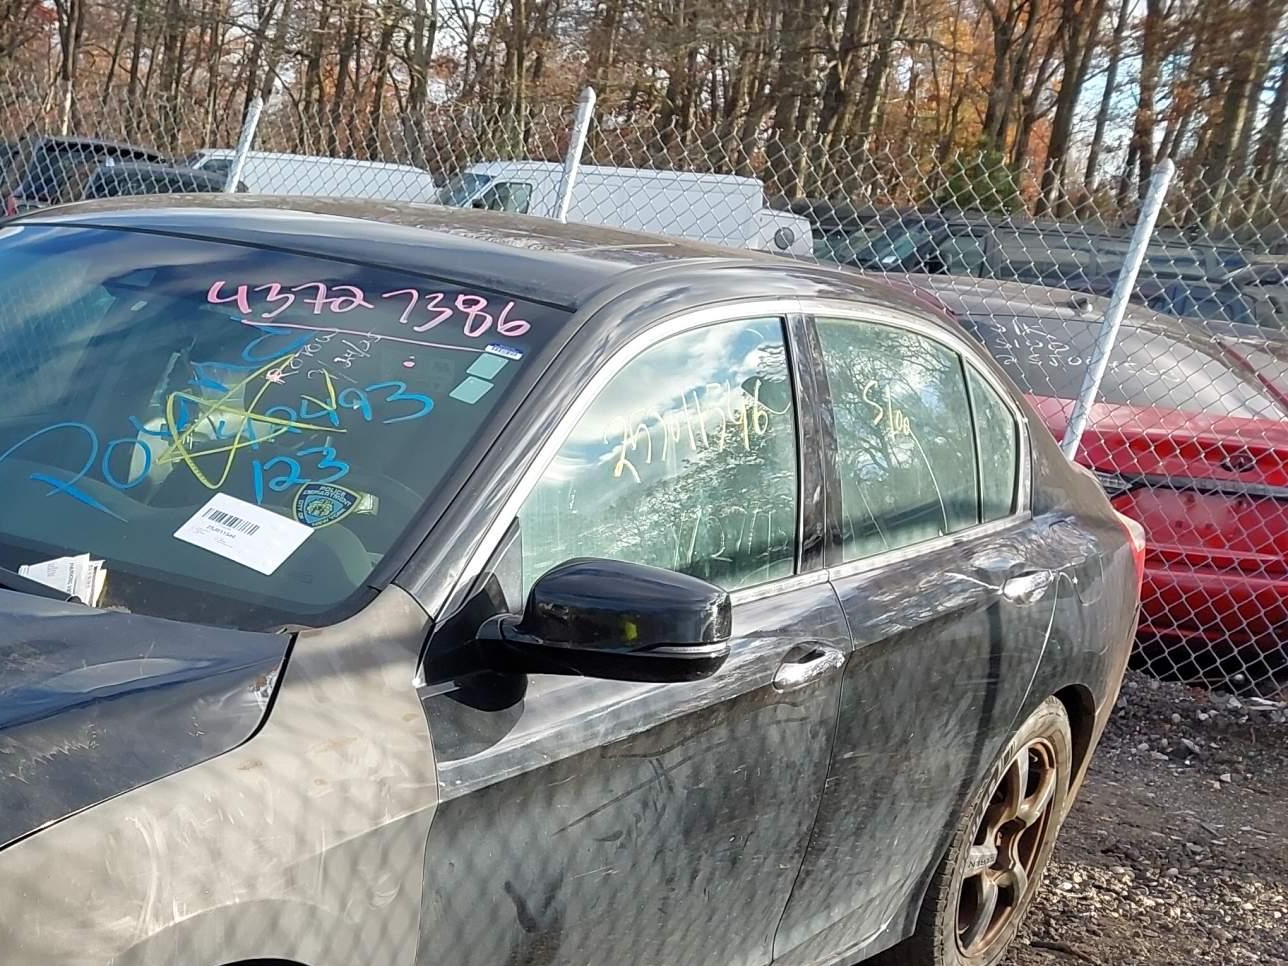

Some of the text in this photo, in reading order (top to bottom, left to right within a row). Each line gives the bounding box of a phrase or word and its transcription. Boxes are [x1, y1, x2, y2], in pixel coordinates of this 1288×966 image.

[207, 280, 531, 338] 43727386
[252, 443, 350, 505] 123
[319, 485, 347, 500] POLICE
